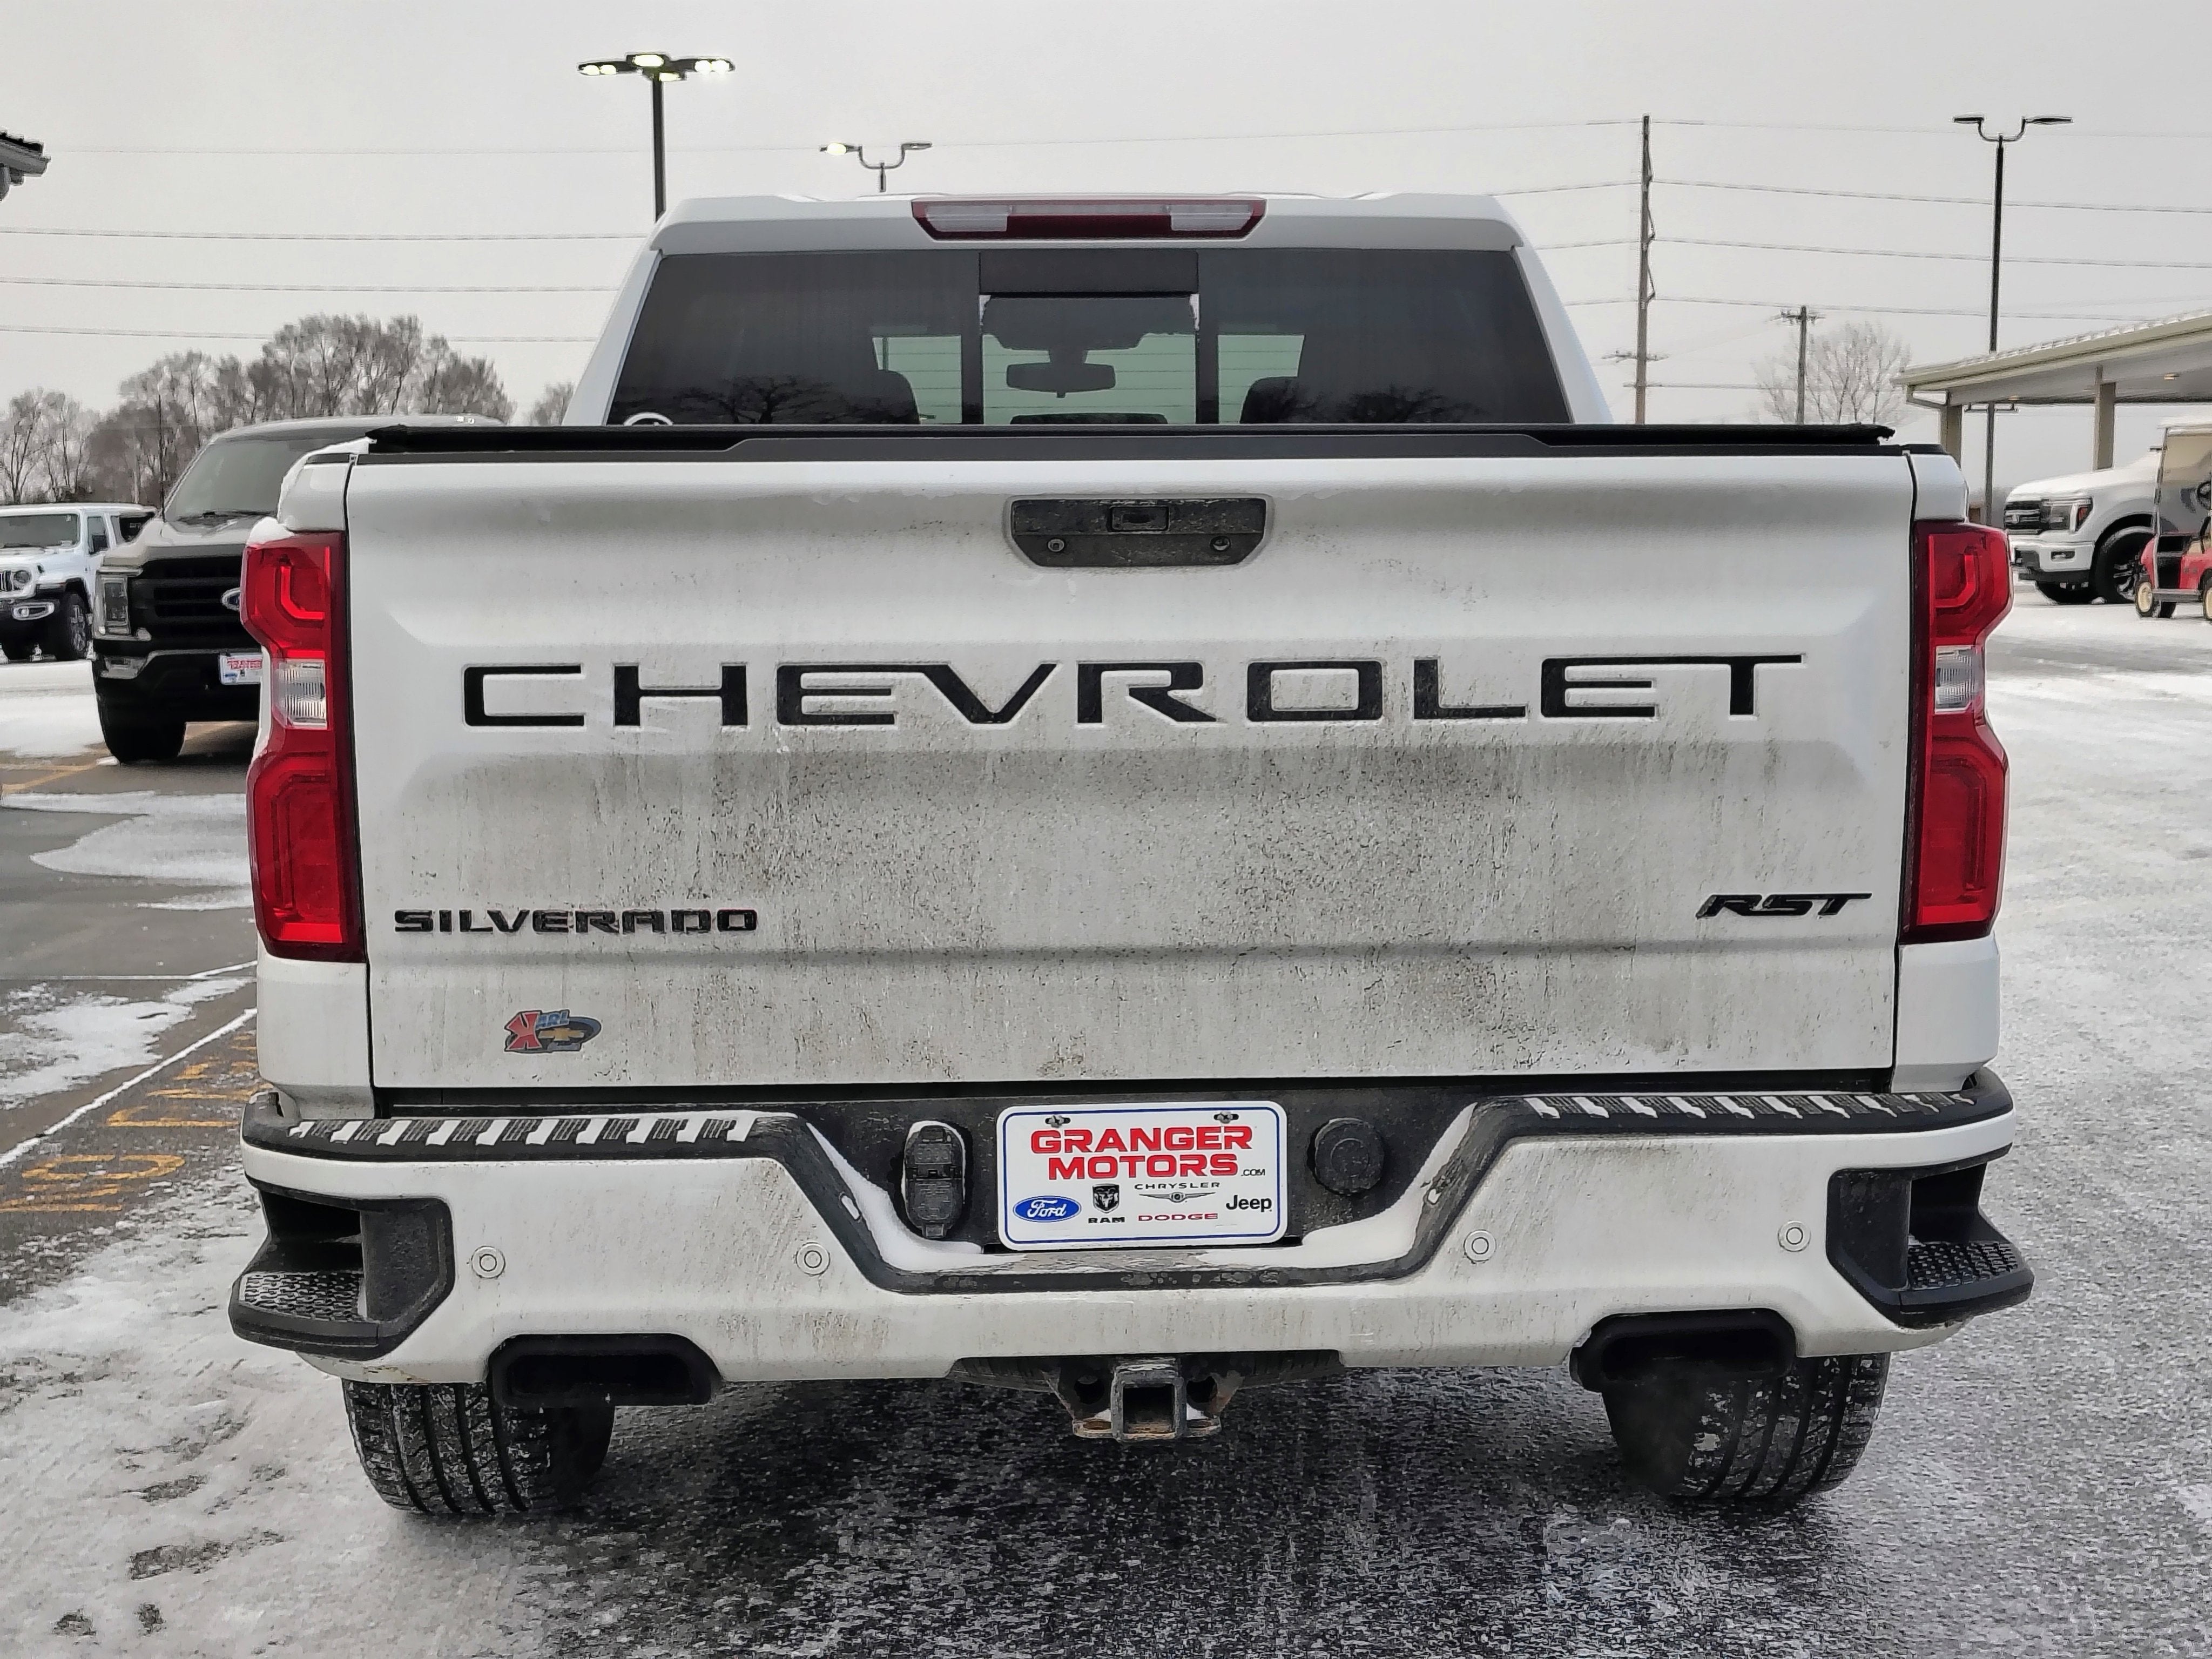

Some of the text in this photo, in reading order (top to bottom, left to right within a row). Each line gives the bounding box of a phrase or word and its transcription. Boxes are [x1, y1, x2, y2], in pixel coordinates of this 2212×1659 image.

[463, 655, 1803, 726] CHEVROLET
[1695, 893, 1872, 918] RST
[394, 909, 757, 934] SILVERADO
[1031, 1126, 1253, 1154] GRANGER
[1027, 1199, 1067, 1218] Ford
[1226, 1195, 1272, 1212] Jeep
[1138, 1213, 1218, 1222] DODGE
